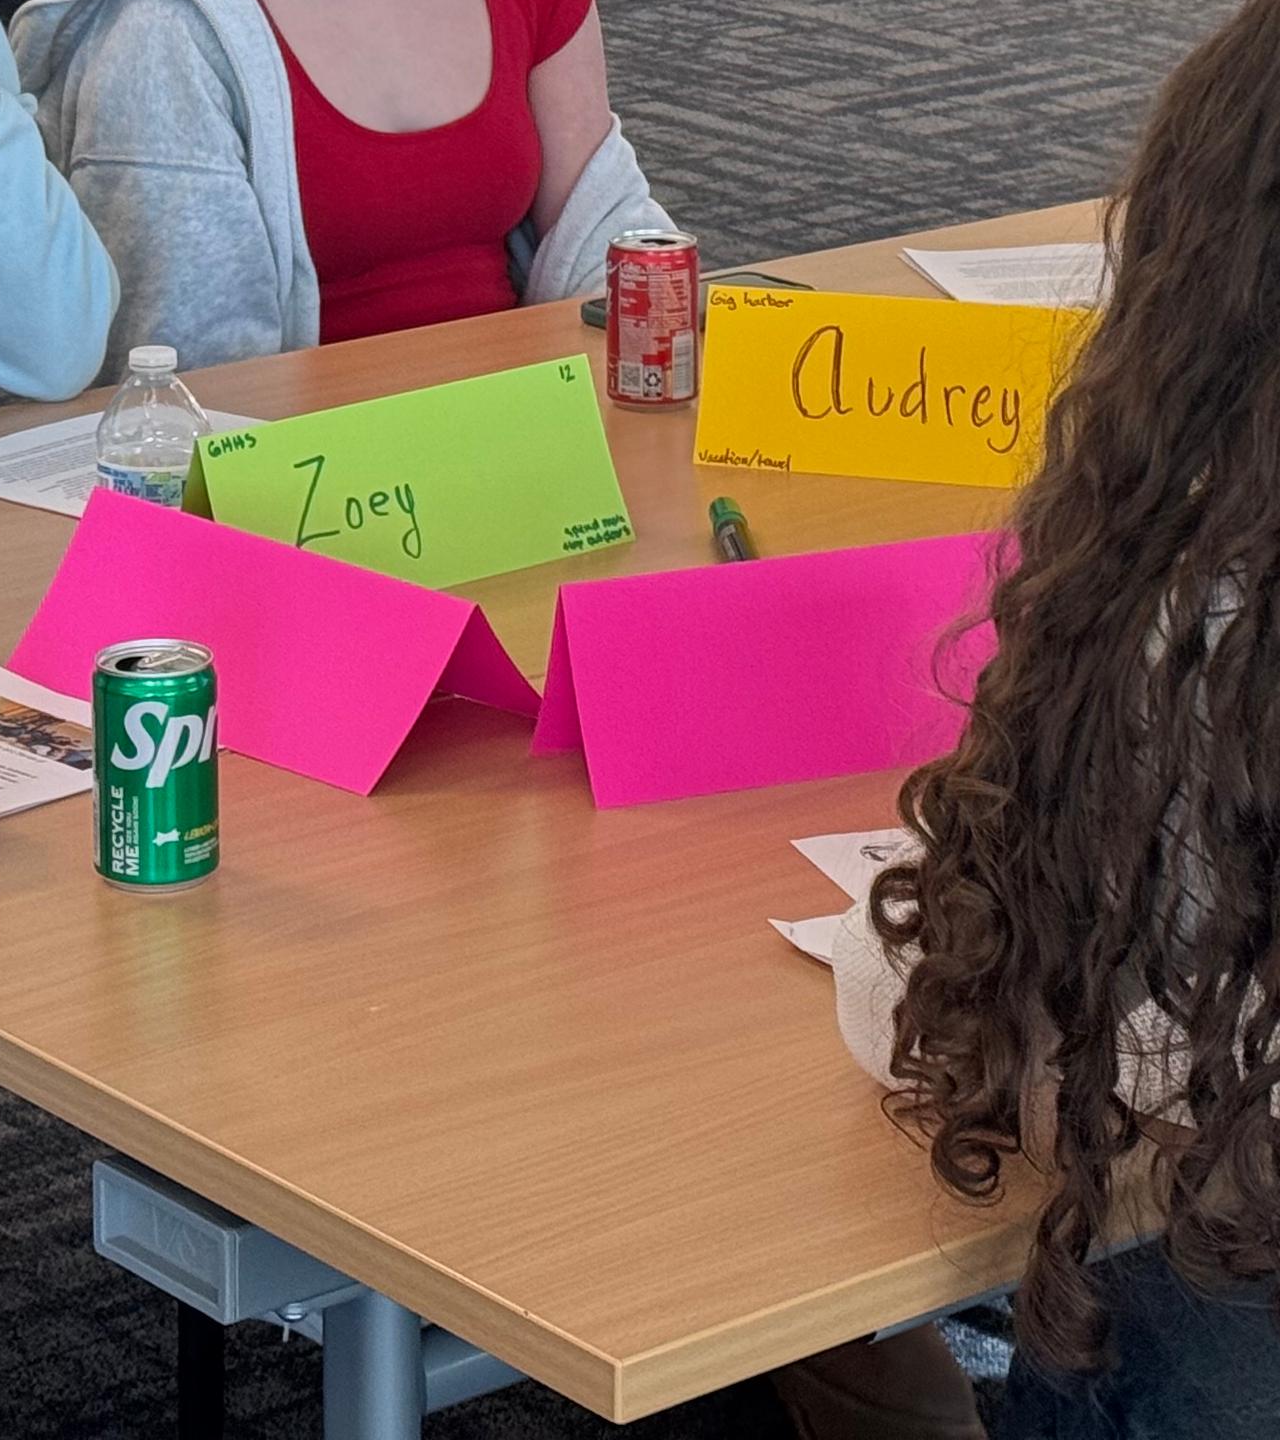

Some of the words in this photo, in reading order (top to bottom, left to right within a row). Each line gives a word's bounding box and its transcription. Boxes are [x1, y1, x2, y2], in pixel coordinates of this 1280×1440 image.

[559, 364, 576, 382] 12
[207, 432, 257, 459] GHHS
[293, 455, 422, 559] Zoey
[111, 785, 125, 875] RECYCLE
[125, 846, 140, 876] ME
